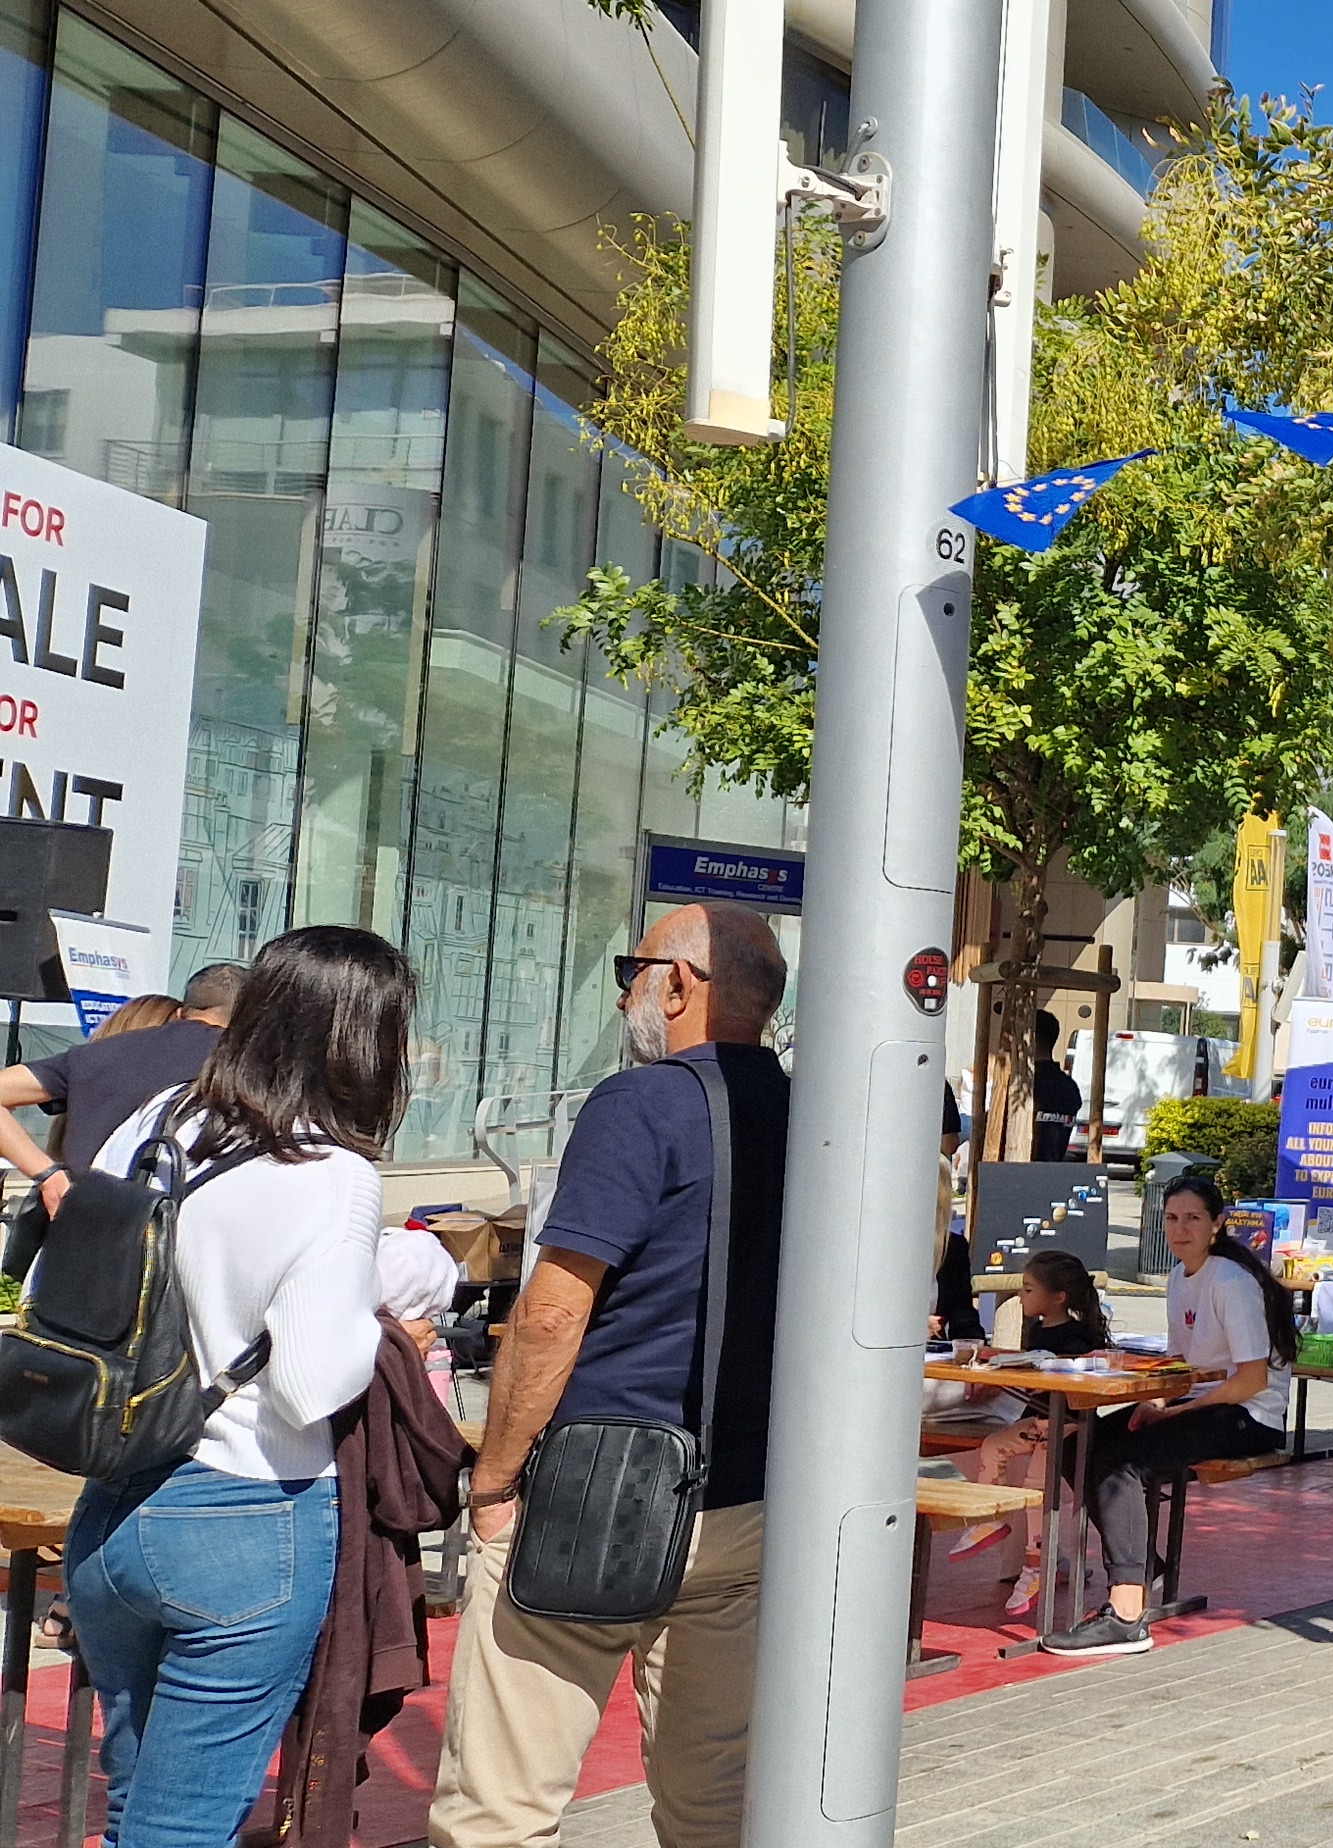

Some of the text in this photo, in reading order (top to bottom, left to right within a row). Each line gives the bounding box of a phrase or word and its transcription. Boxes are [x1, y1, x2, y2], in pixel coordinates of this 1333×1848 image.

[2, 490, 66, 547] FOR
[936, 528, 965, 564] 62
[1286, 1137, 1305, 1150] ALL
[1294, 1169, 1307, 1183] TO
